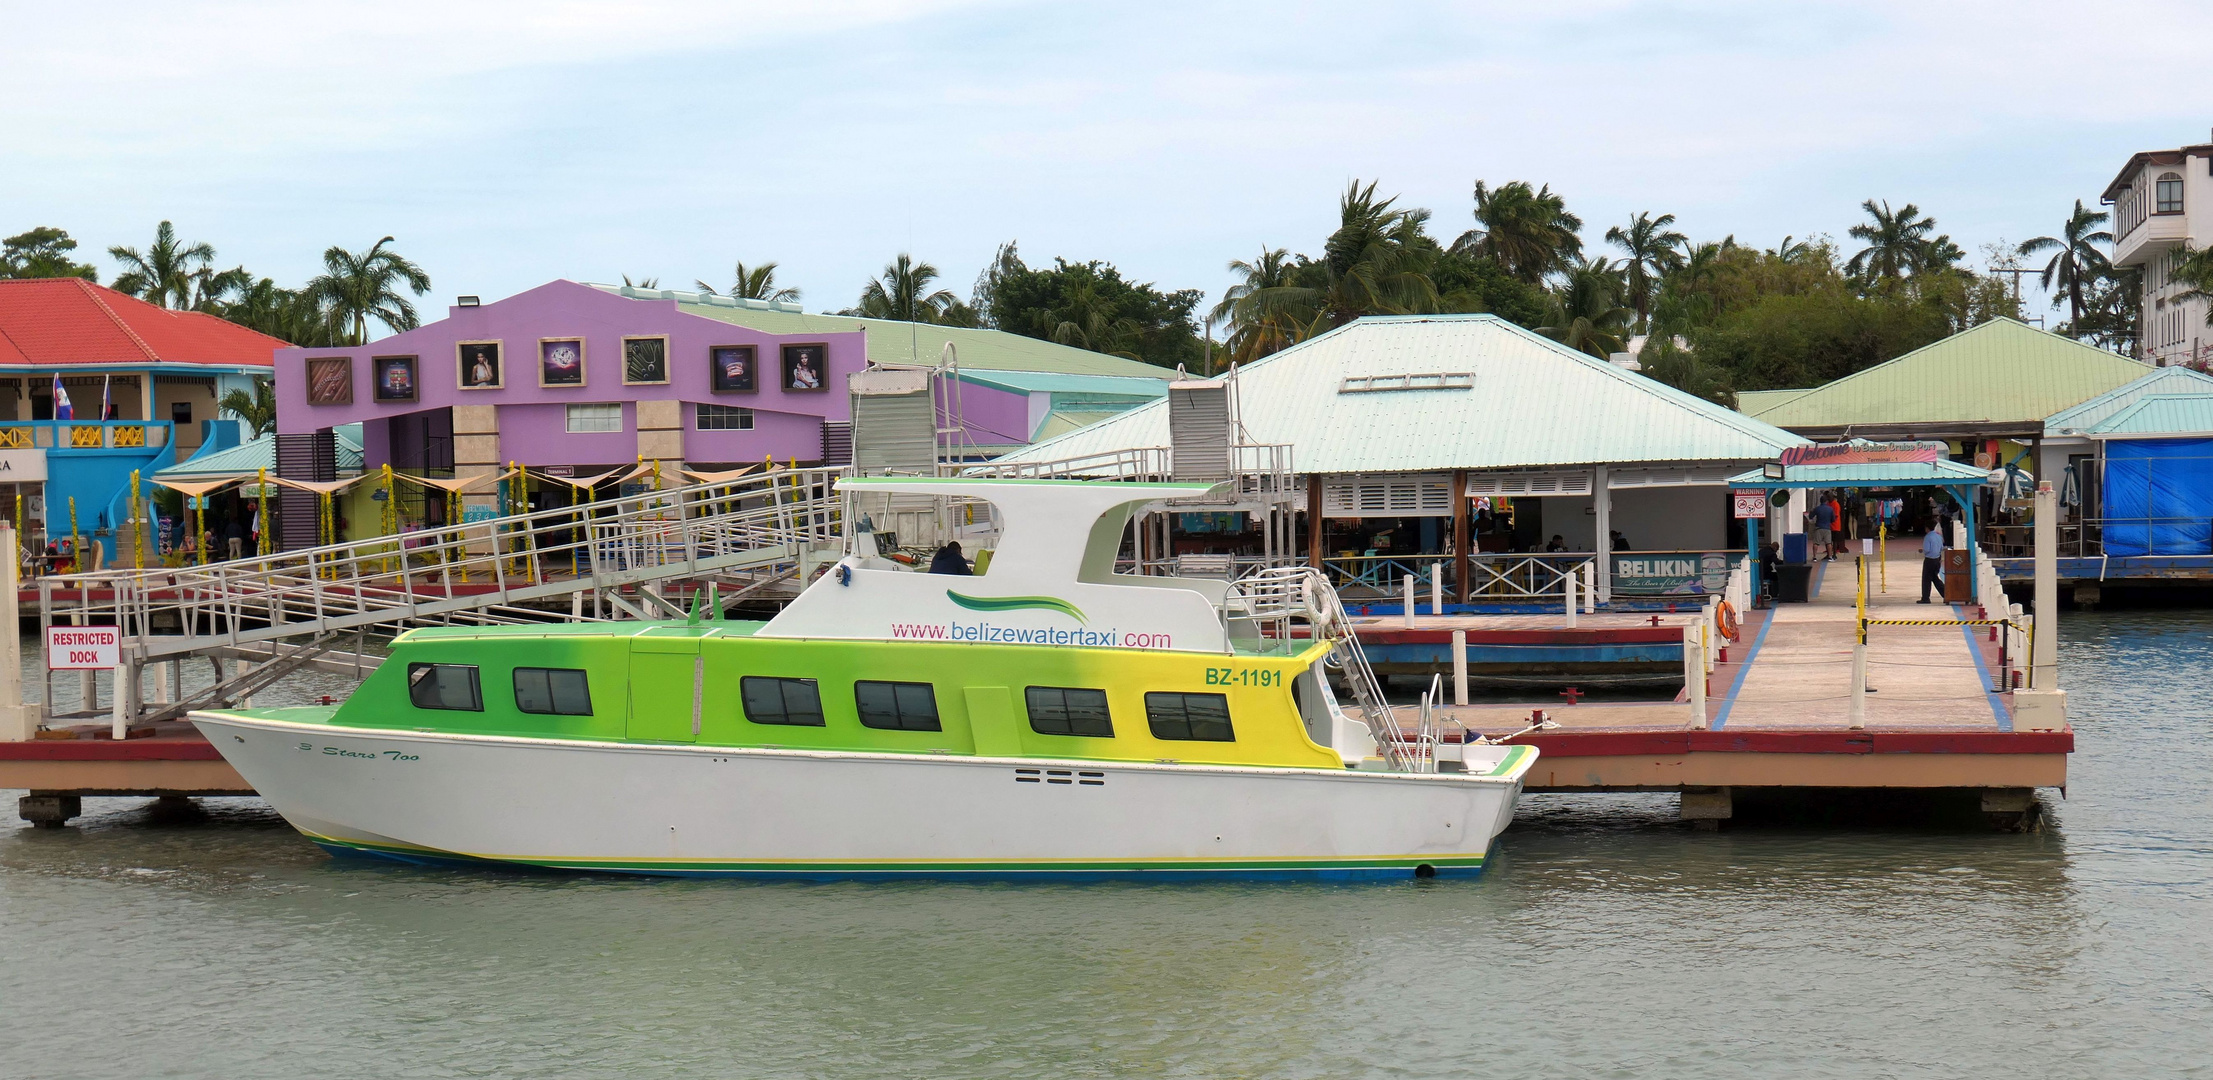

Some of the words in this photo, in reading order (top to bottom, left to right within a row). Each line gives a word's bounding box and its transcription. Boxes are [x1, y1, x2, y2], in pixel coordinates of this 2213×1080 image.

[1780, 442, 1850, 466] Welcome
[1861, 443, 1887, 452] Belize
[1889, 441, 1915, 452] Cruise
[1916, 441, 1936, 451] Port
[1618, 560, 1695, 578] BELIKIN
[53, 632, 114, 646] RESTRICTED
[891, 621, 1171, 648] www.belizewatertaxi.com
[69, 650, 99, 664] DOCK
[1205, 667, 1281, 688] BZ-1191
[299, 742, 312, 751] 3
[322, 746, 377, 759] Stars
[383, 750, 420, 761] Too
